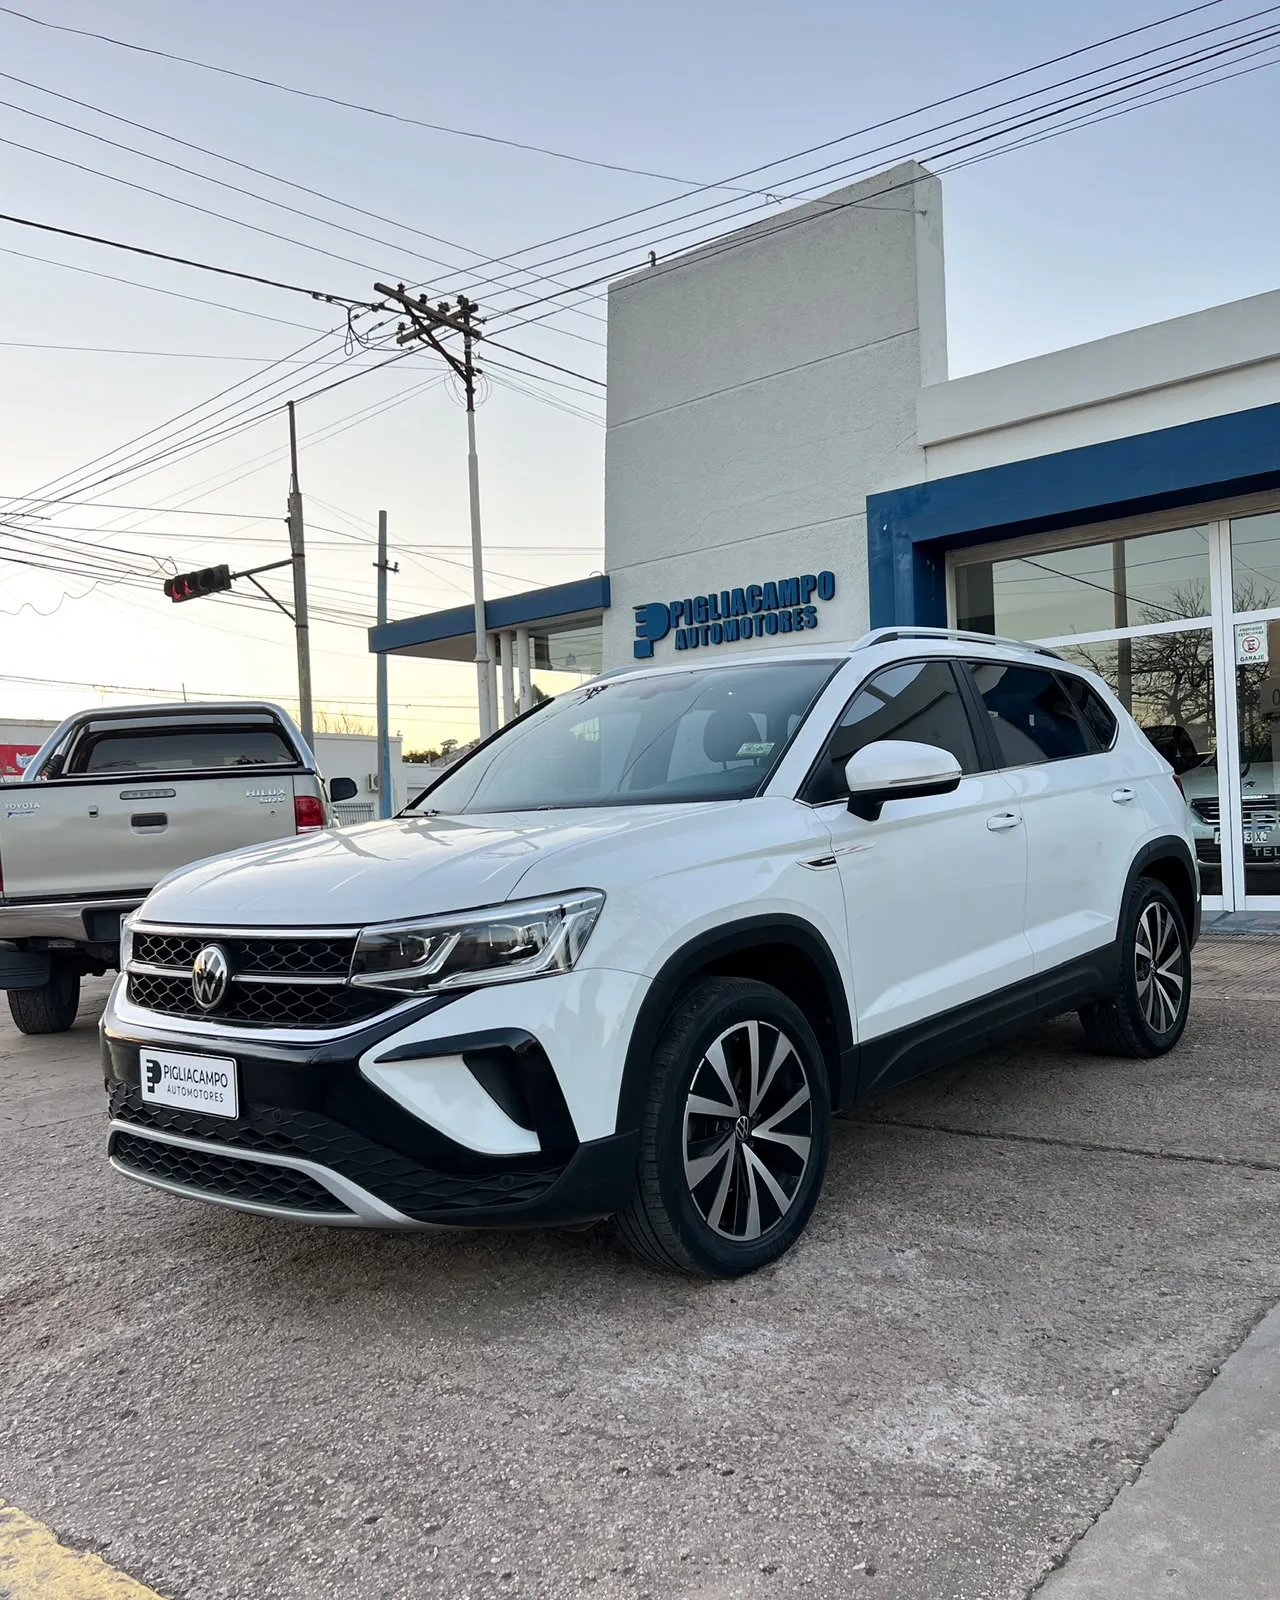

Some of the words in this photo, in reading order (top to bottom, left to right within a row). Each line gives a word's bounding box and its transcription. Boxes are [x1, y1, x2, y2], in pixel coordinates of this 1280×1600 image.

[669, 570, 836, 628] PIGLIACAMPO
[674, 605, 818, 651] AUTOMOTORES
[1240, 654, 1265, 663] GARAJE
[246, 787, 287, 796] HILUX
[5, 802, 41, 811] TOYOTA
[163, 1064, 228, 1088] PIGLIACAMPO
[167, 1084, 224, 1103] AUTOMOTORES
